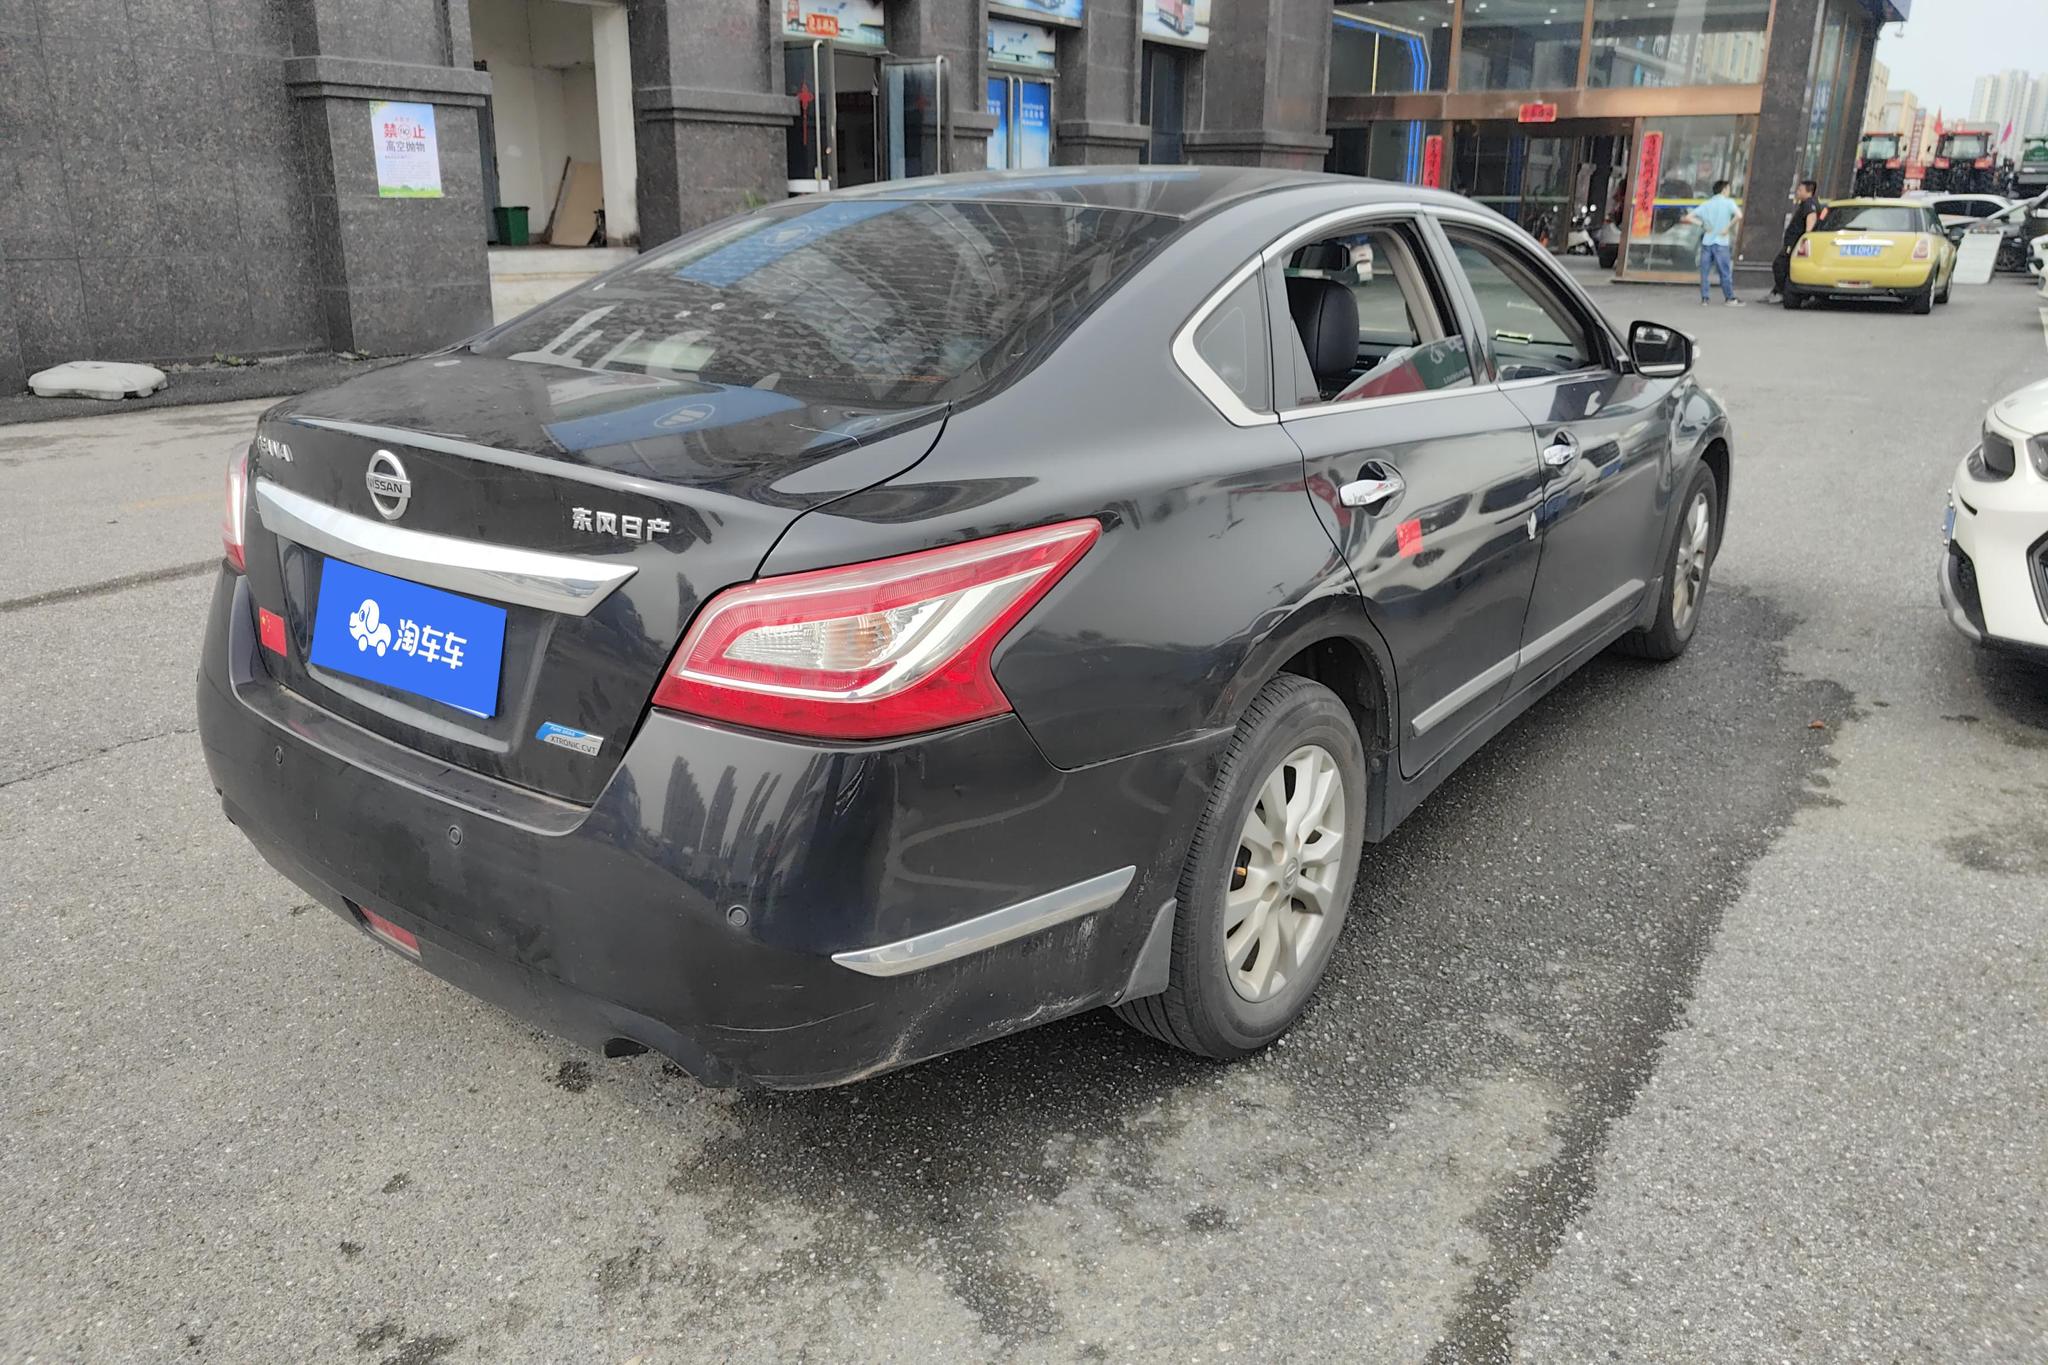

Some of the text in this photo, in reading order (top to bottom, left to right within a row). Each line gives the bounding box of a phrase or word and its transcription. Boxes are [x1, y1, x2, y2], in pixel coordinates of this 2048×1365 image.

[368, 477, 403, 494] NISSAN
[571, 506, 671, 541] 东风日产
[550, 735, 598, 753] XTRONIC CVT
